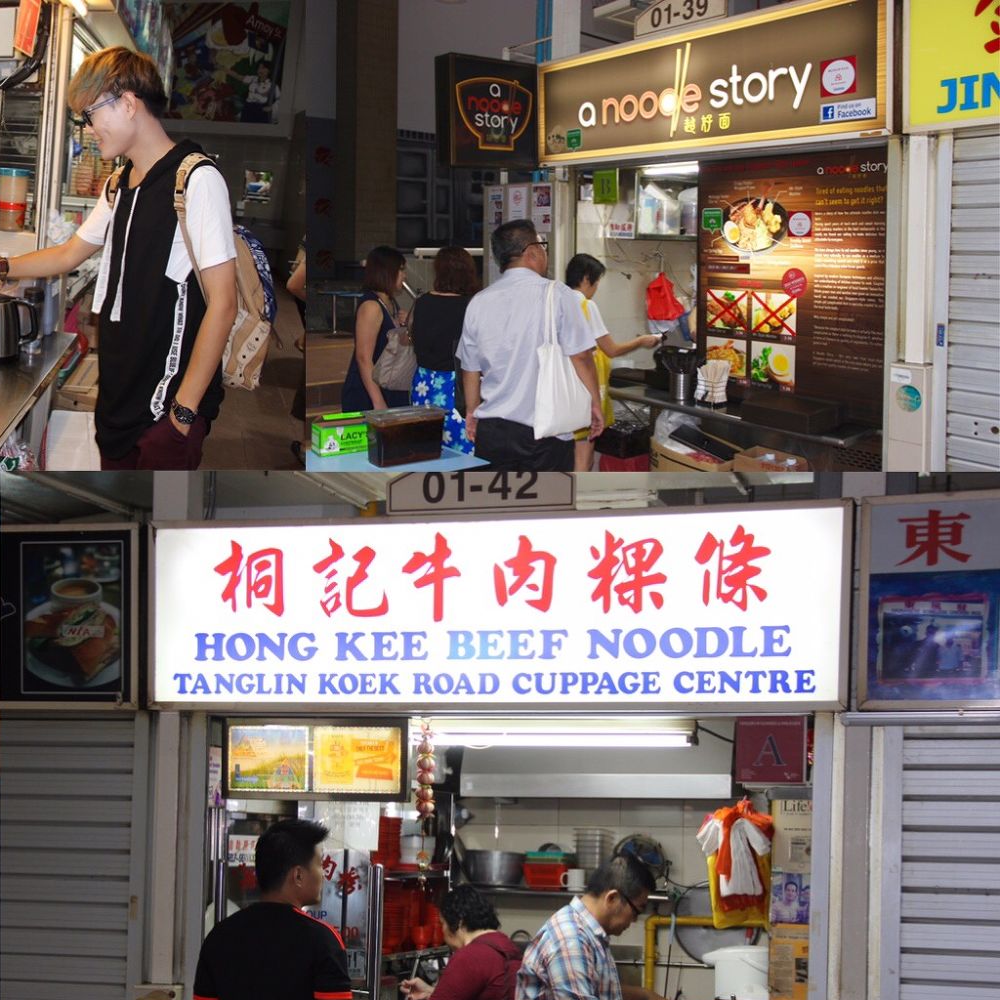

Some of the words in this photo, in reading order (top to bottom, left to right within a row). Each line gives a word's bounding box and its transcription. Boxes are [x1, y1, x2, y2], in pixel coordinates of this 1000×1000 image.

[651, 0, 709, 28] 01-39
[489, 83, 502, 98] a
[578, 102, 597, 128] a
[602, 50, 702, 130] noodle
[709, 62, 813, 110] story
[475, 112, 519, 134] story
[837, 107, 872, 119] Facebook
[816, 166, 825, 175] a
[860, 161, 888, 174] story
[423, 472, 538, 503] 01-42
[894, 509, 973, 567] 東
[213, 524, 772, 622] 桐記牛肉粿條
[194, 632, 318, 661] HONG
[335, 631, 429, 661] KEE
[447, 629, 569, 660] BEEF
[586, 625, 793, 660] NOODLE
[173, 672, 306, 695] TANGLIN
[318, 672, 401, 695] KOEK
[413, 672, 500, 695] ROAD
[512, 671, 661, 695] CUPPAGE
[673, 669, 816, 694] CENTRE
[752, 733, 788, 767] A
[306, 910, 328, 920] OUP
